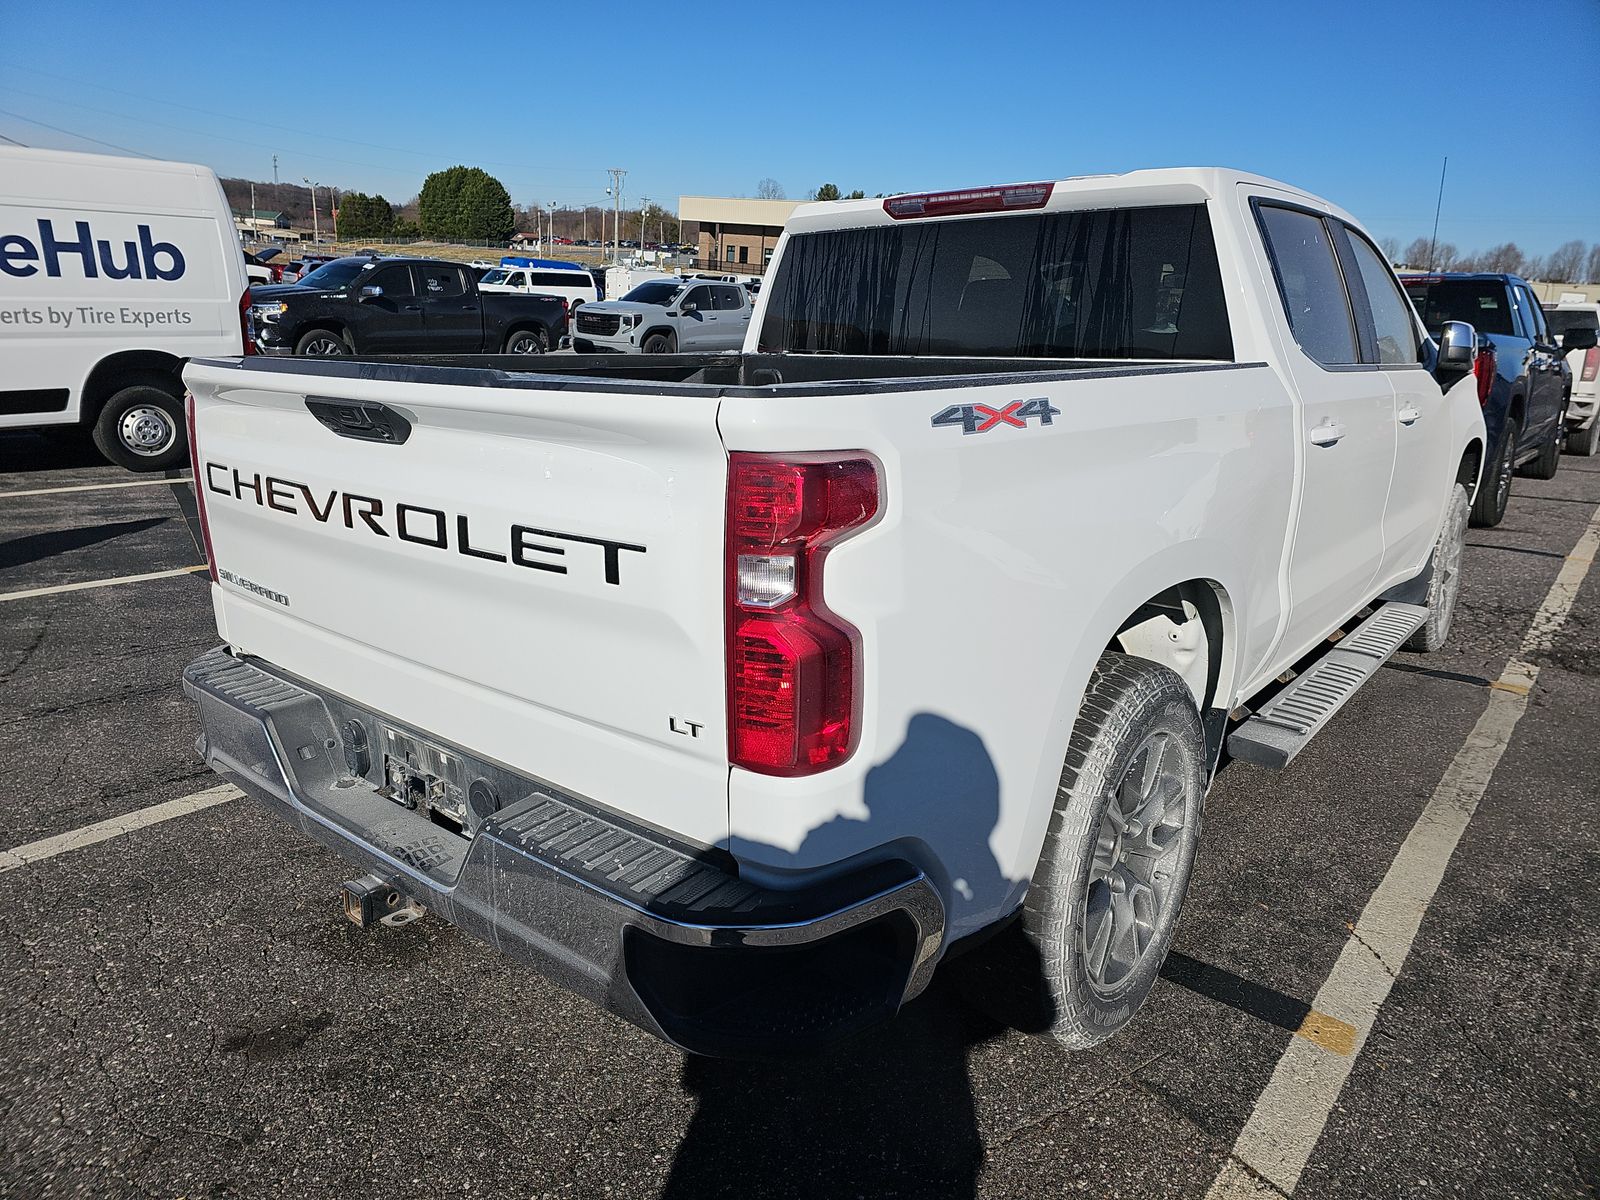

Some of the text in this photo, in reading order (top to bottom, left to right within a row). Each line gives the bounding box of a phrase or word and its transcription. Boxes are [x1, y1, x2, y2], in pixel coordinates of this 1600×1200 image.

[0, 218, 186, 281] eHub
[48, 306, 73, 328] by
[76, 307, 115, 324] Tire
[120, 307, 192, 327] Experts
[206, 462, 647, 586] CHEVROLET
[218, 568, 290, 606] SILVERADO
[669, 716, 704, 738] LT
